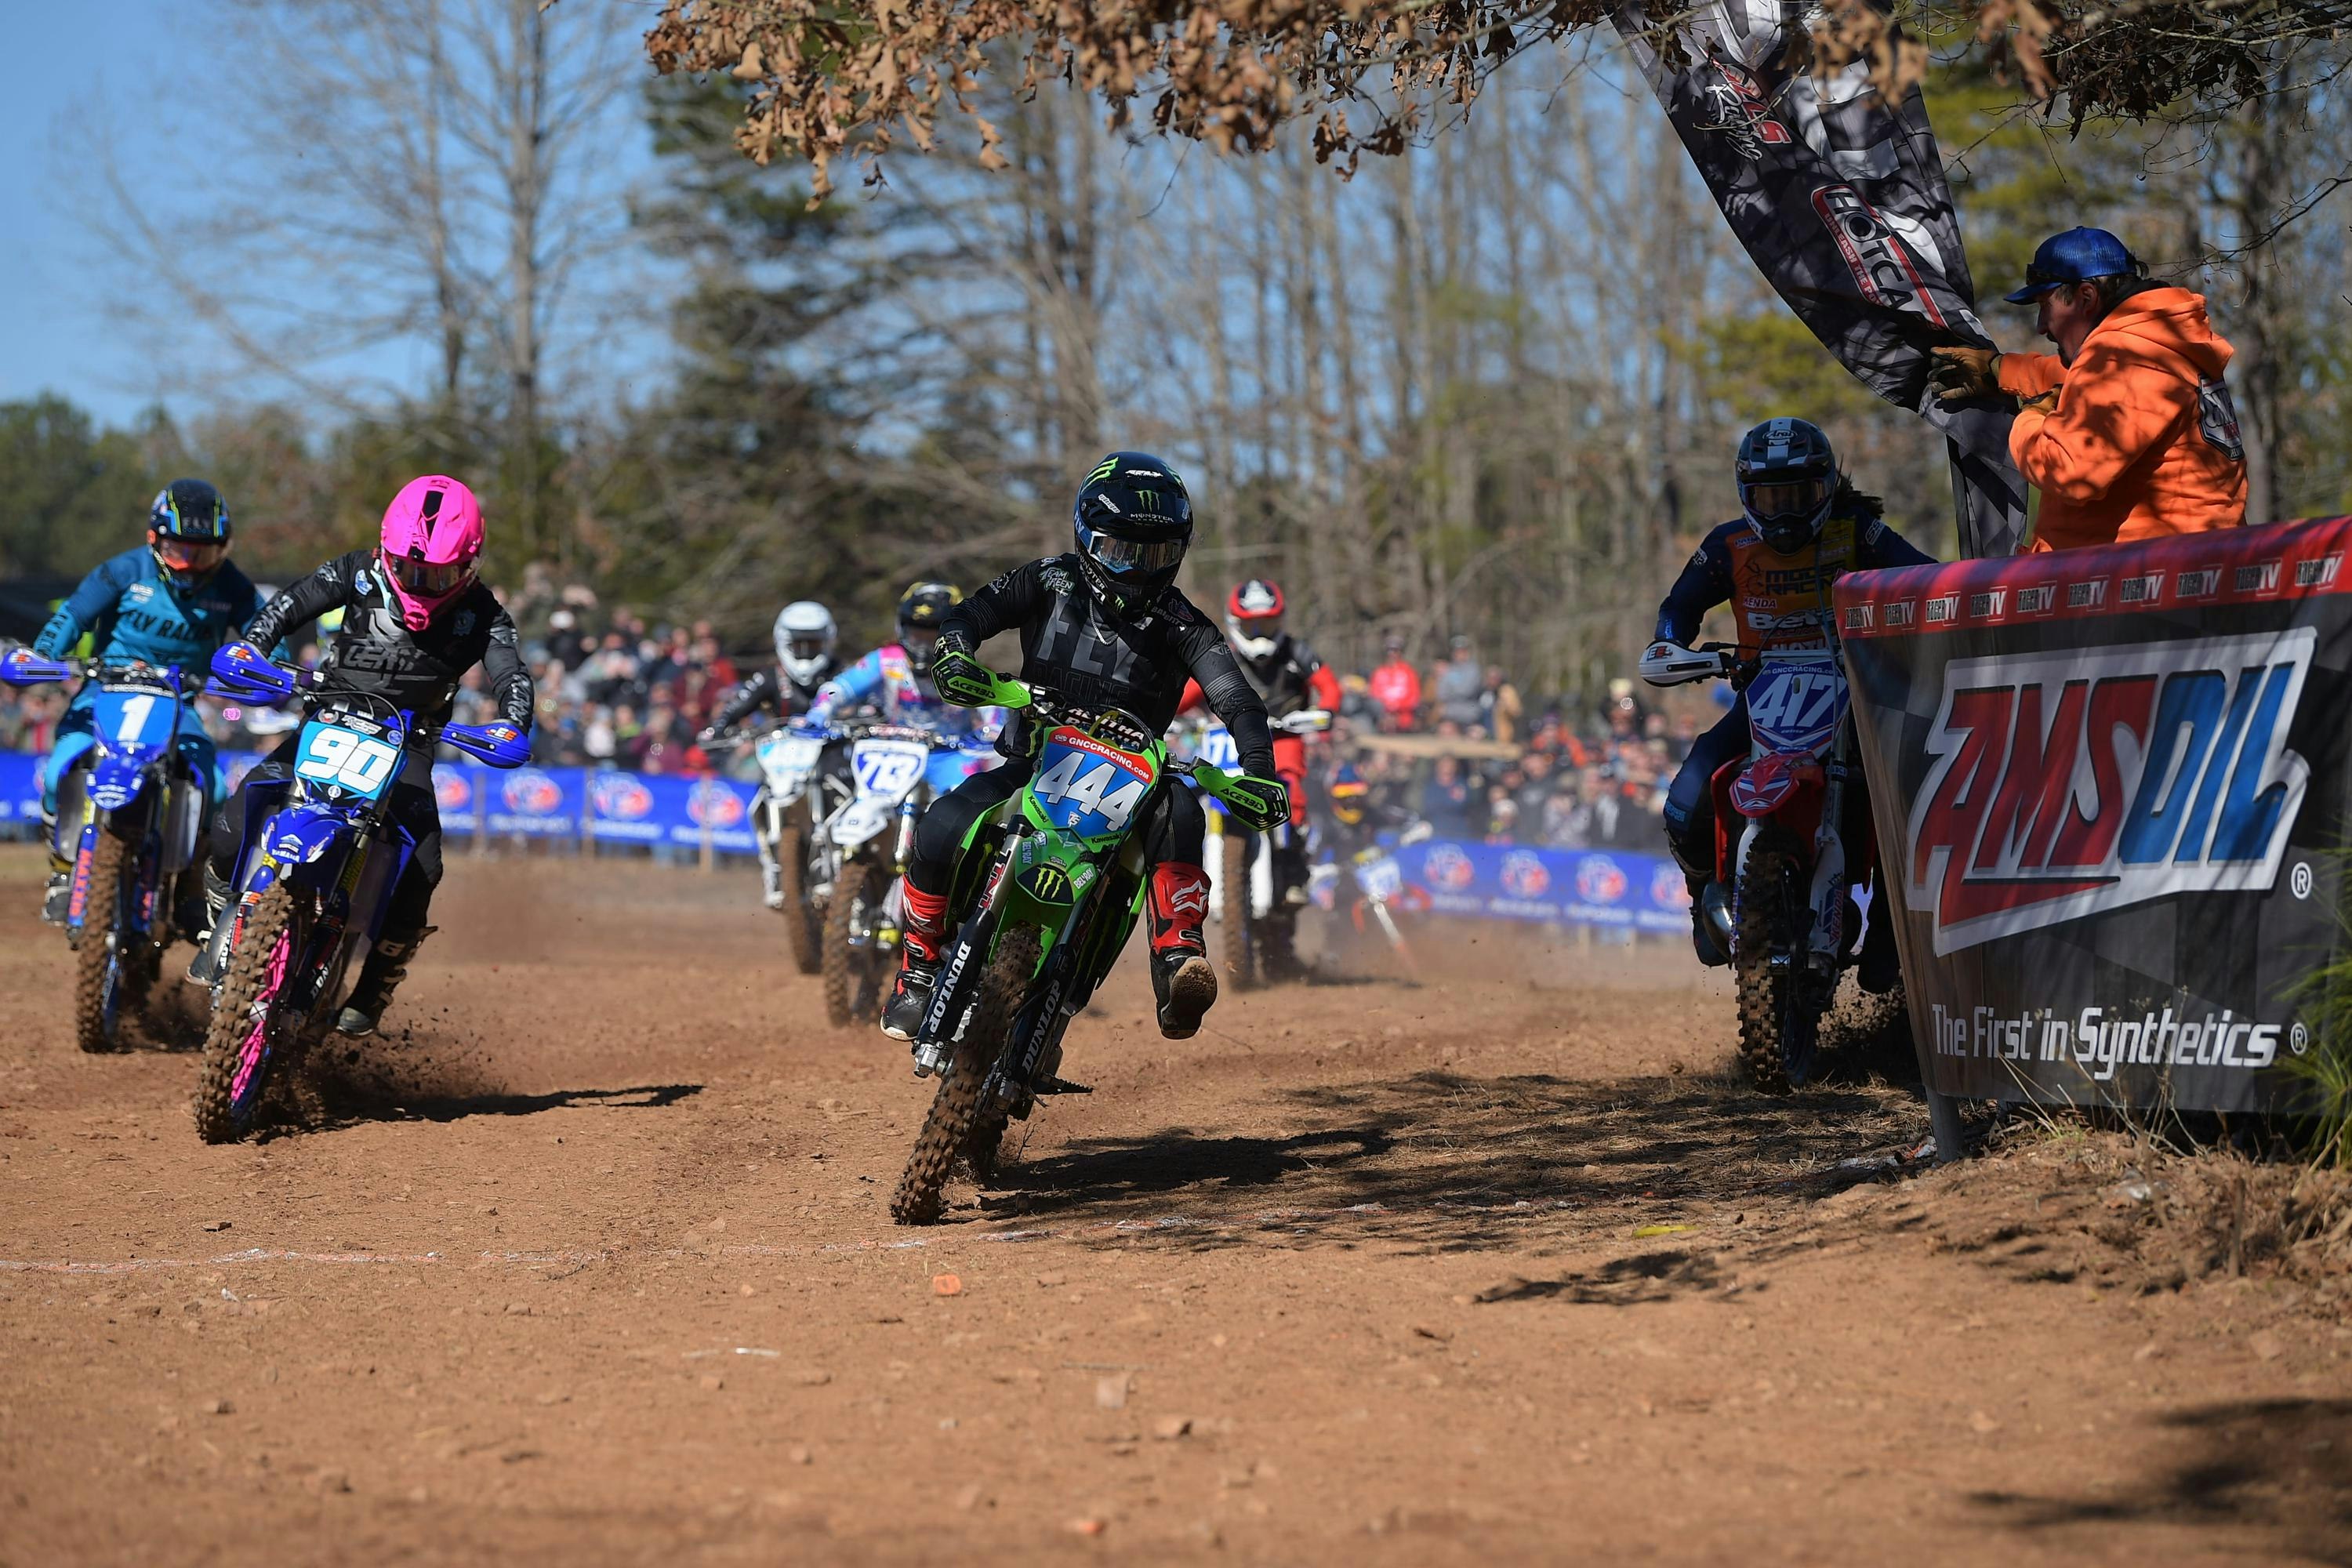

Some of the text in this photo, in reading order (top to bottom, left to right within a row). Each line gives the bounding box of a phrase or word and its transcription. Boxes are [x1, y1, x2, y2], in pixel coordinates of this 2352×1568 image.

[1824, 212, 1859, 263] UNLEASH
[1854, 264, 1868, 286] THE
[1764, 430, 1799, 439] Arai
[1131, 513, 1174, 523] MONSTER
[1040, 568, 1068, 582] TEAM
[1744, 596, 1777, 608] KENDA
[1036, 593, 1138, 684] FLY
[949, 681, 996, 699] ACERBIS
[1750, 673, 1848, 728] 417
[116, 695, 156, 742] 1
[296, 727, 398, 793] 90
[1028, 796, 1049, 823] Kawasaki
[1034, 750, 1147, 833] 444
[1220, 788, 1265, 811] ACERBIS
[1911, 661, 2297, 928] AMSOIL
[271, 848, 300, 862] YAMAHA
[1091, 833, 1124, 844] Kawasaki
[928, 940, 971, 1034] DUNLOP
[1022, 979, 1061, 1075] DUNLOP
[1931, 1004, 1966, 1057] The
[1973, 1006, 2032, 1061] First
[2039, 1007, 2070, 1062] in
[2074, 1007, 2281, 1080] Synthetics
